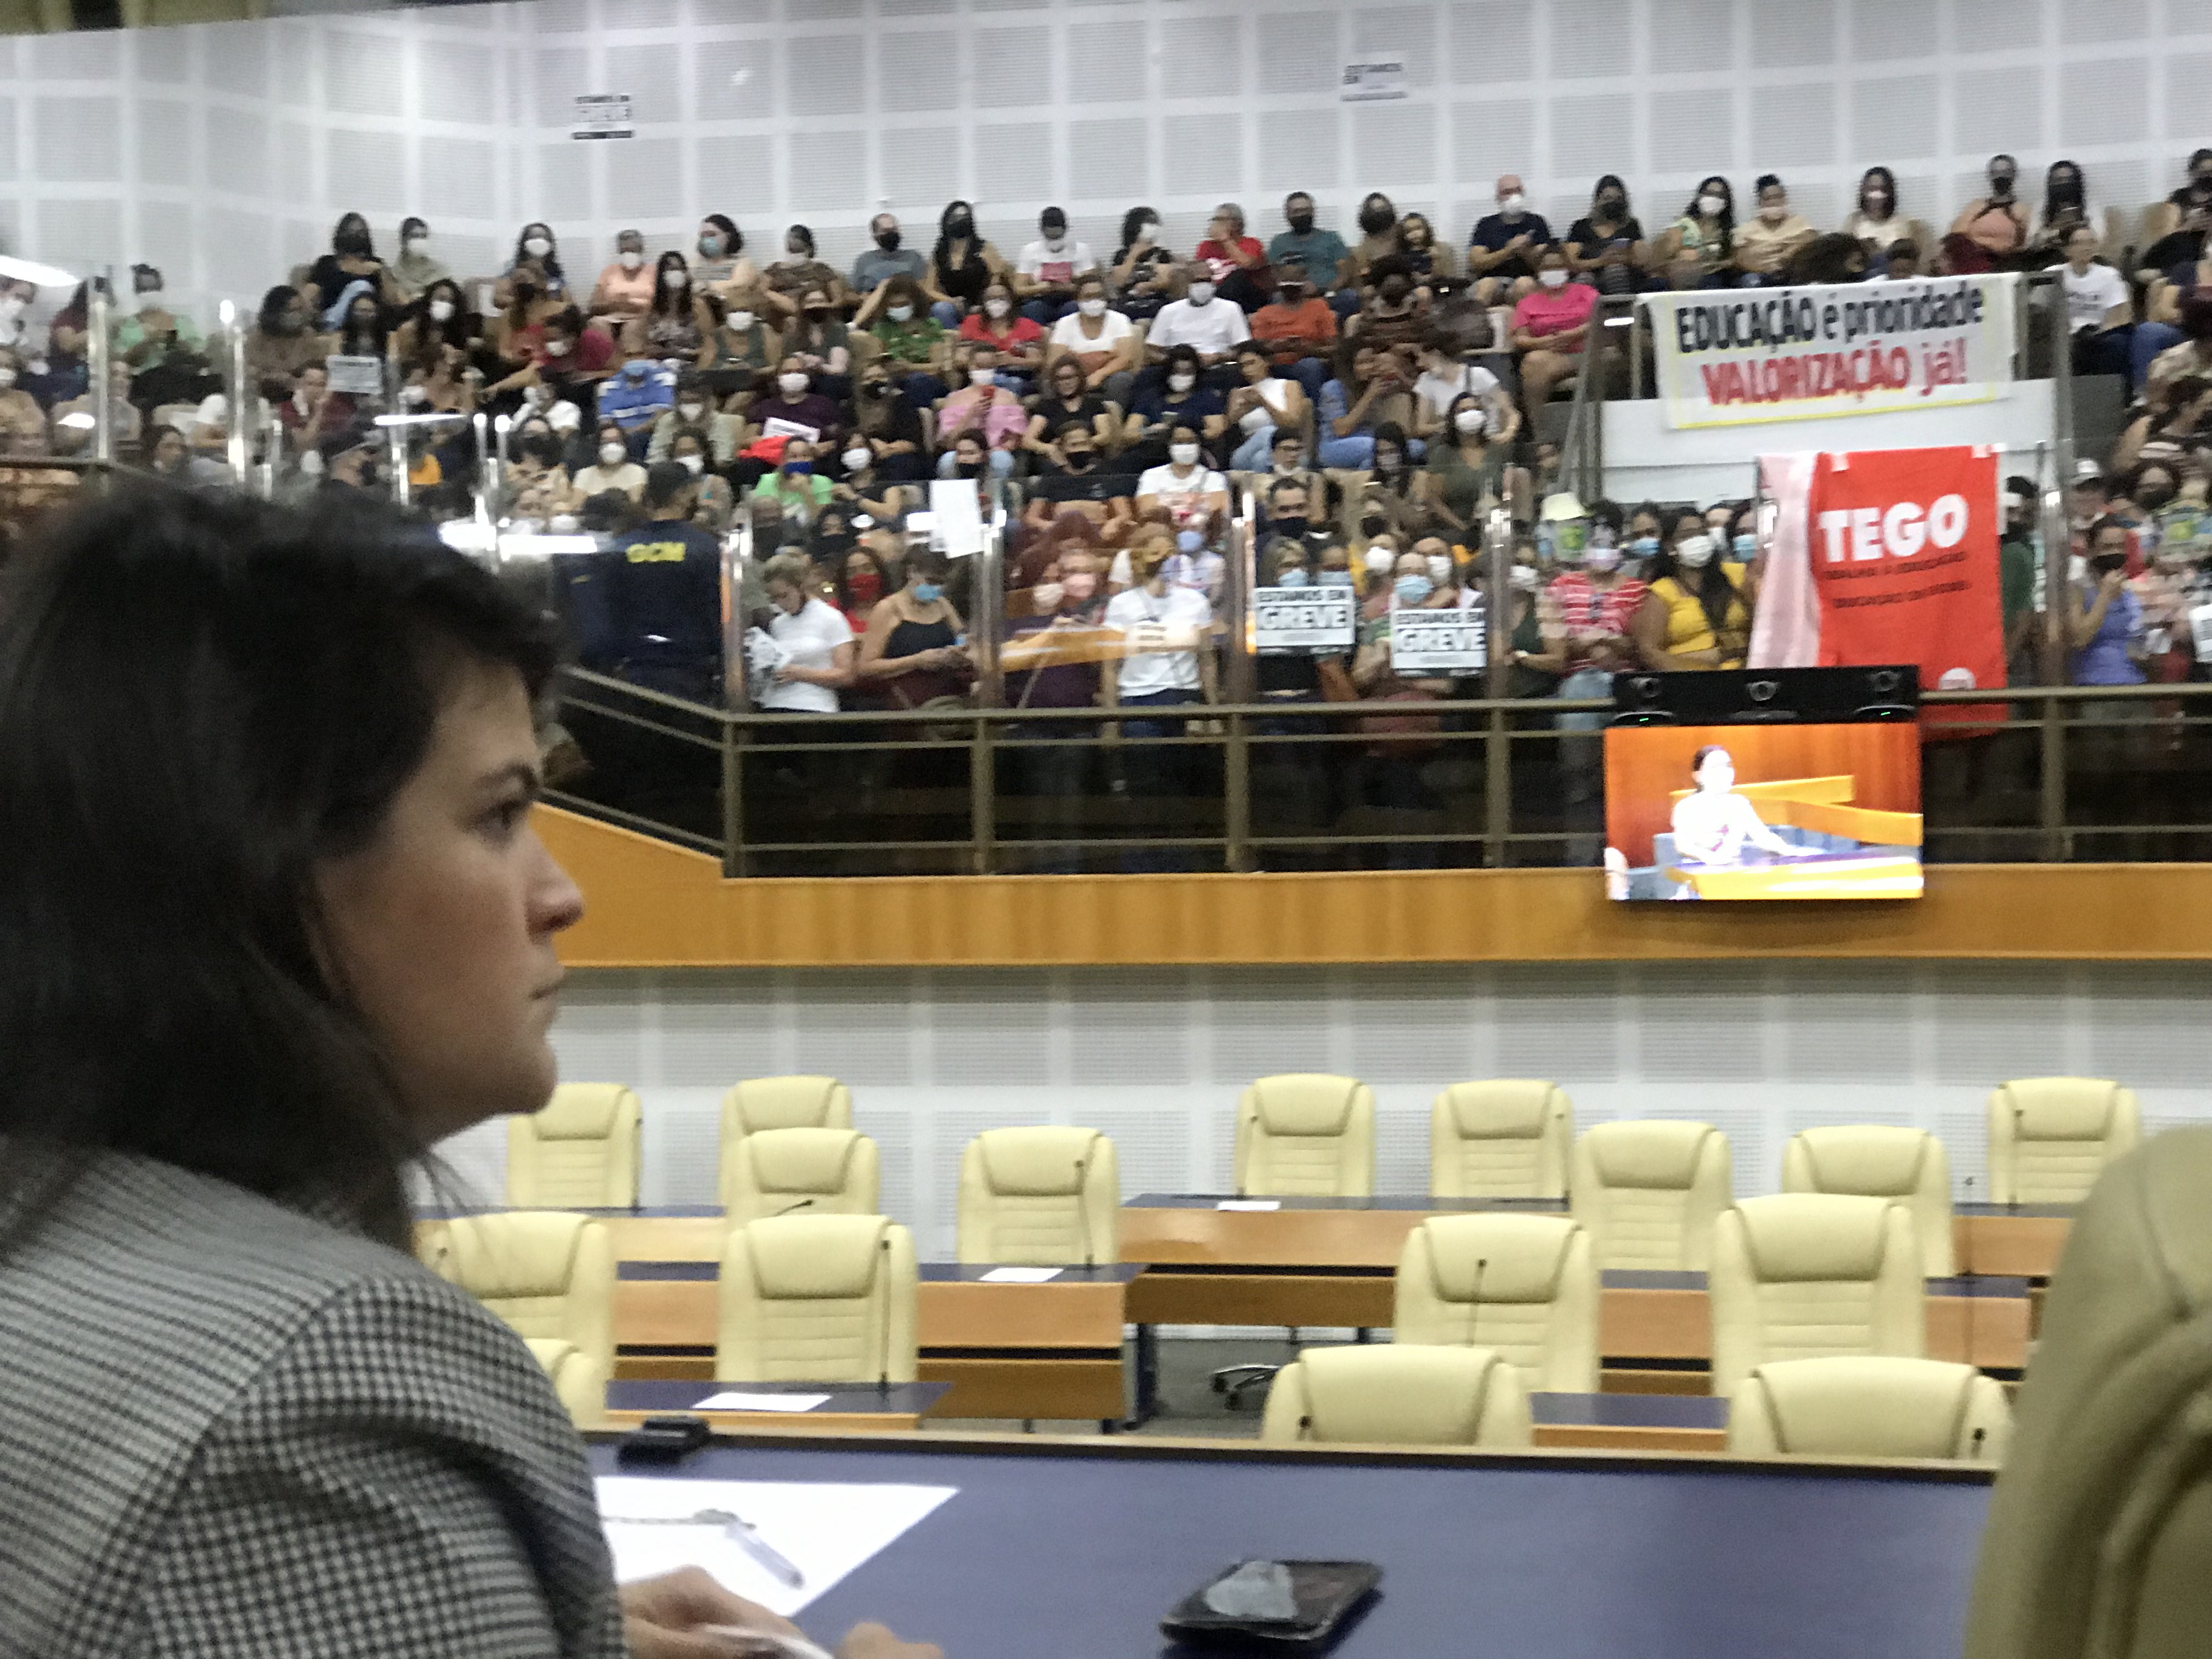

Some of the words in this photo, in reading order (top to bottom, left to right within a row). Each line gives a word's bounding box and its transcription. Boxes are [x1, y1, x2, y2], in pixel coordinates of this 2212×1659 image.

[1675, 291, 1817, 353] EDUCAÇÃO
[1822, 292, 1838, 340] é
[1844, 280, 1984, 343] prioridade
[1701, 340, 1911, 405] VALORIZAÇÃO
[1918, 337, 1967, 396] já!
[1818, 494, 1970, 563] TEGO
[1261, 606, 1347, 629] GREVE
